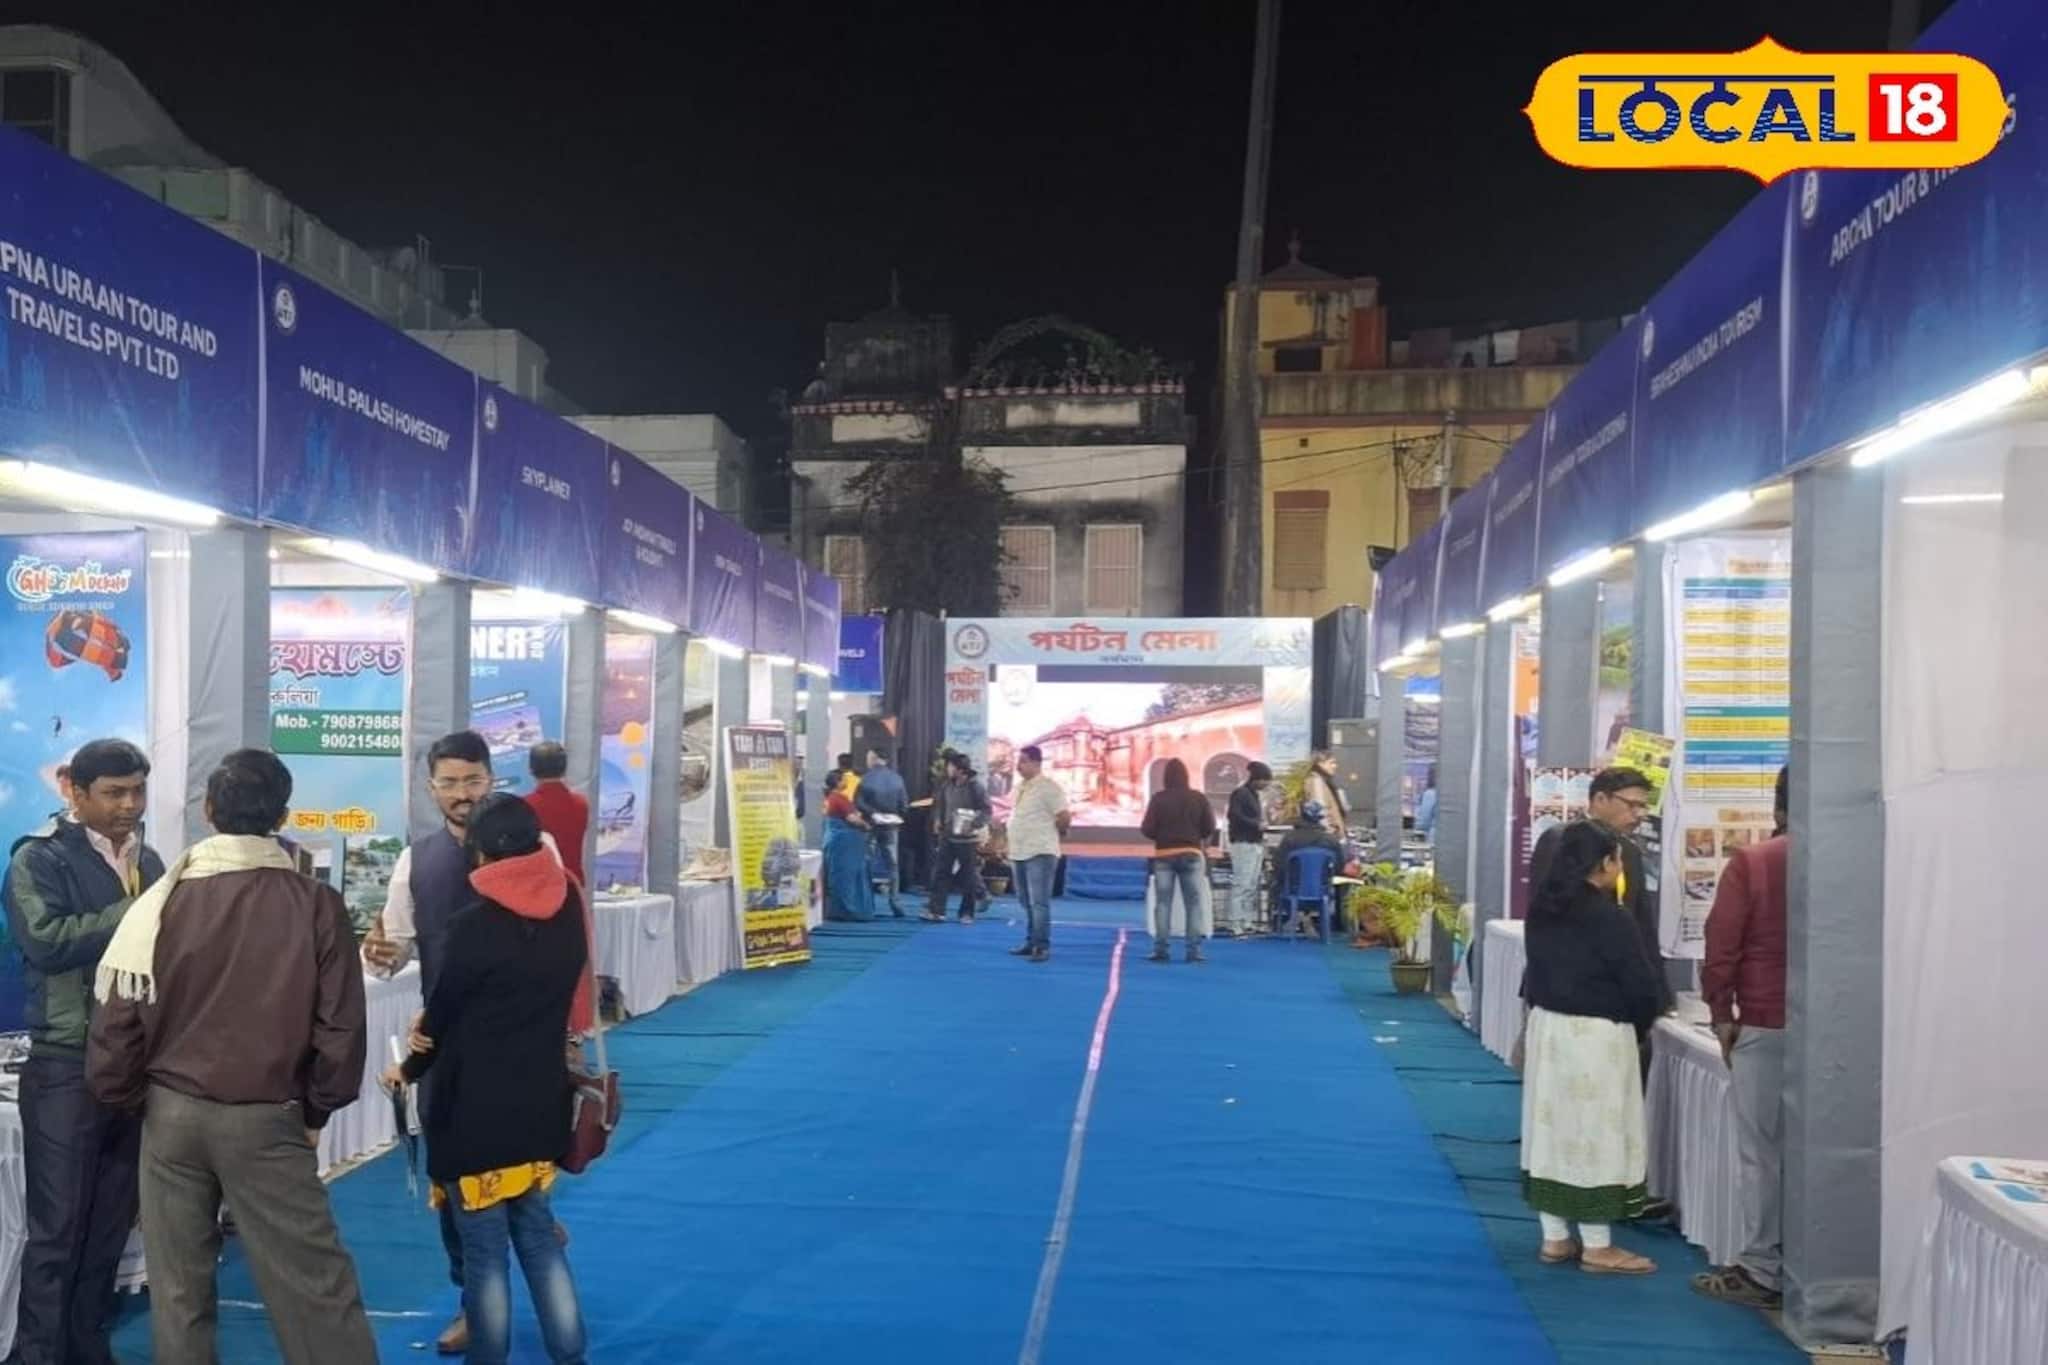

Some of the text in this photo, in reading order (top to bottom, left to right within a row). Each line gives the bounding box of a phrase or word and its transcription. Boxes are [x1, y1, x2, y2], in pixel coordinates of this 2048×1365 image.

[1873, 170, 1917, 230] TOUR
[0, 240, 218, 357] PNA URAAN TOUR AND
[6, 286, 180, 380] TRAVELS PVT LTD
[300, 365, 451, 451] MOHUL PALASH HOMESTAY
[1140, 630, 1221, 651] মেলা
[321, 713, 404, 729] 790879868
[950, 689, 981, 704] মেলা
